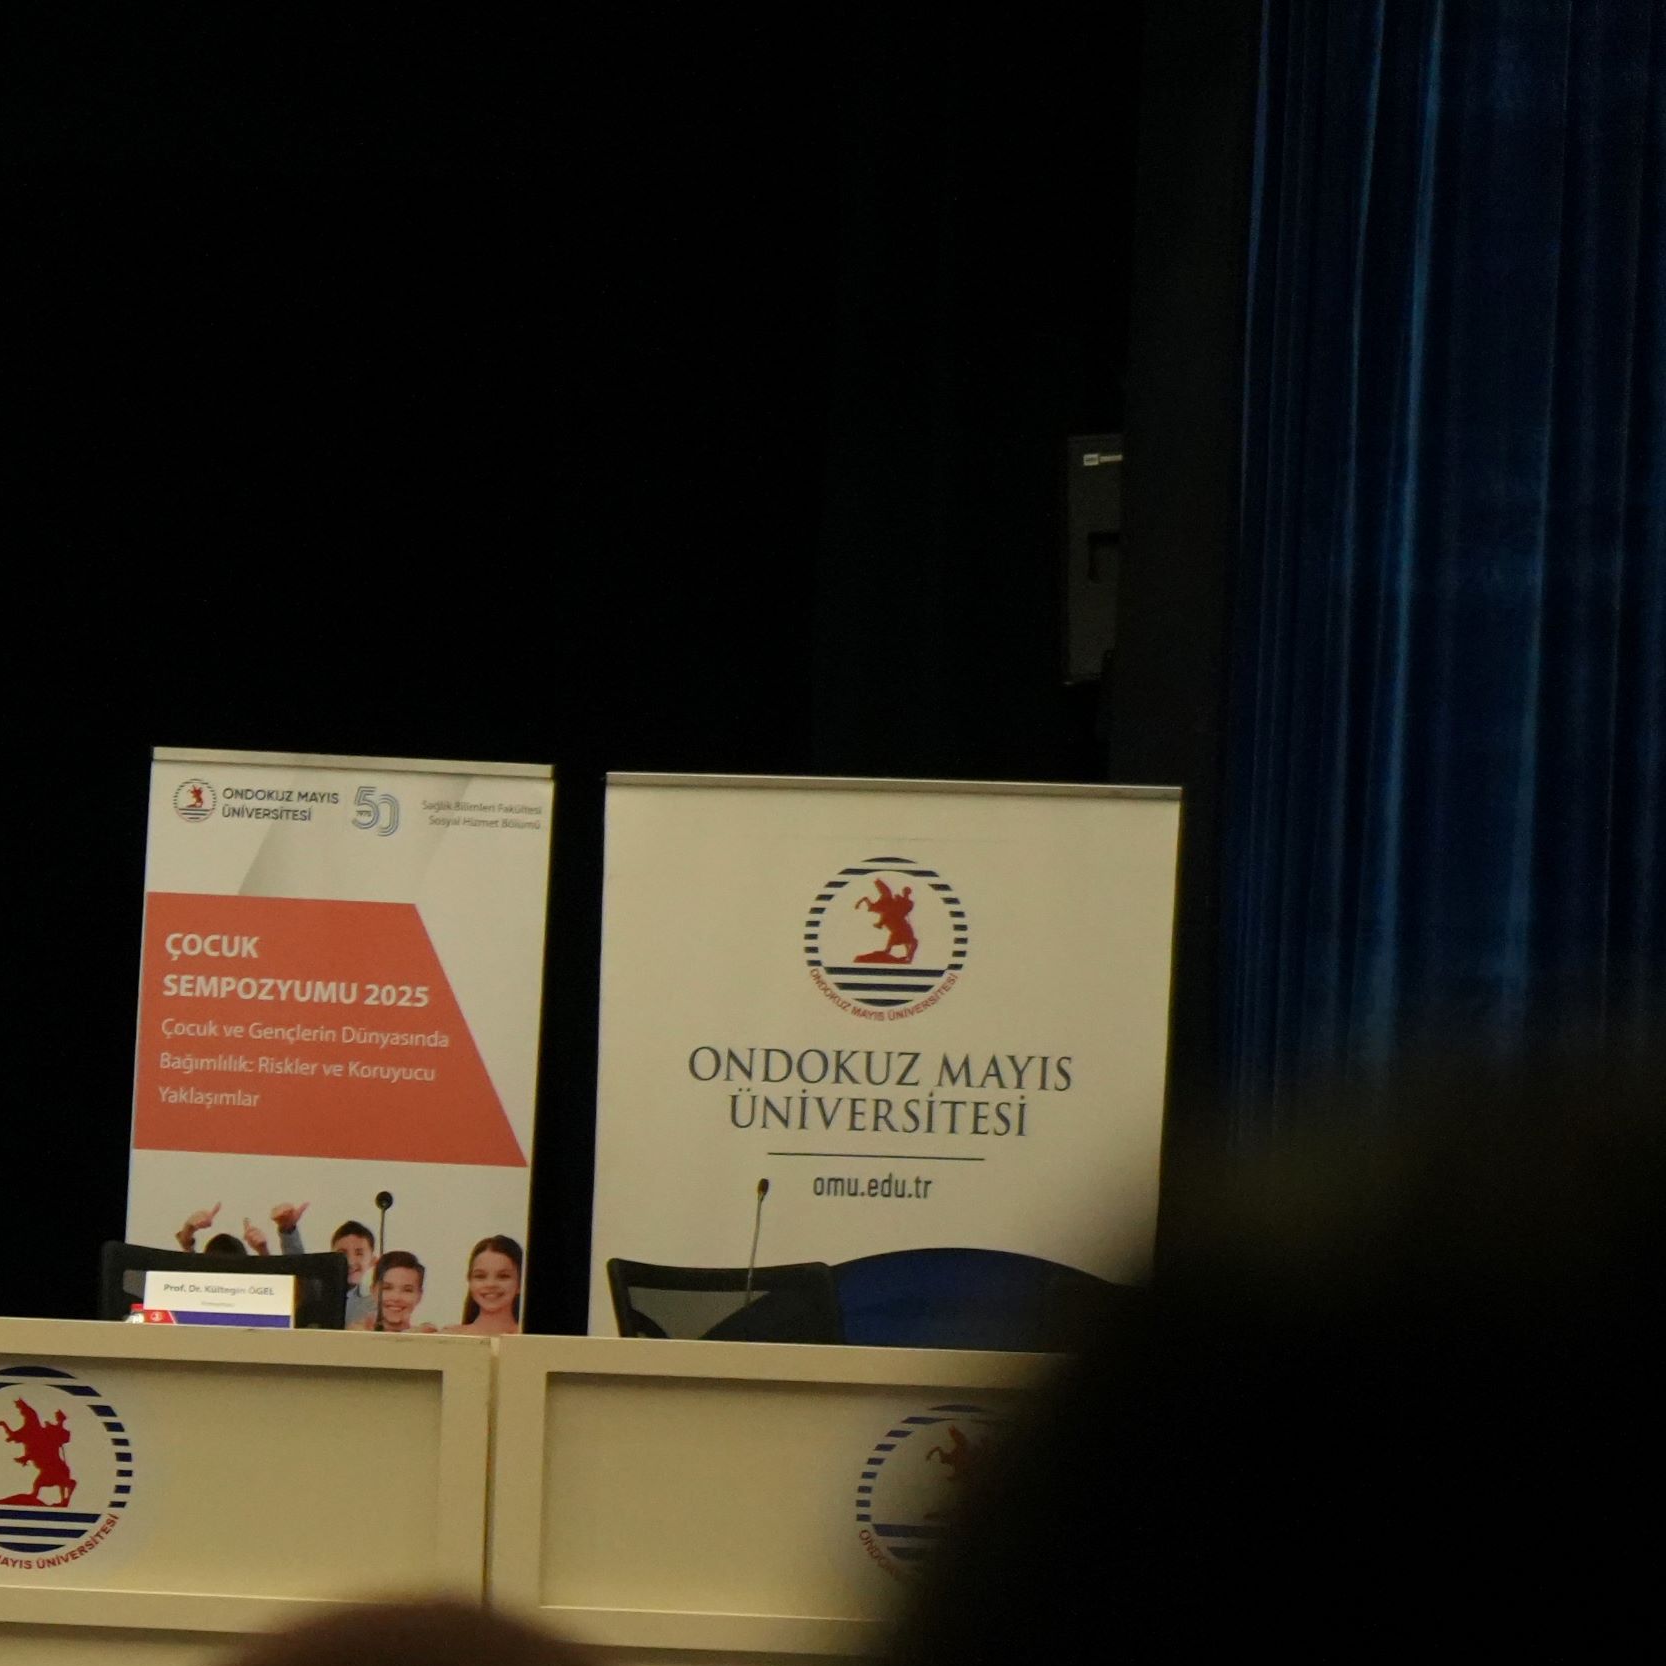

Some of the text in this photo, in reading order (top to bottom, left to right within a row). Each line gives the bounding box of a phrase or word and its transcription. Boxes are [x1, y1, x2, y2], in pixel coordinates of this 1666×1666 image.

[222, 787, 339, 805] ONDOKUZ MAYIS
[222, 804, 312, 822] ÜNİVERSİTESİ
[351, 785, 400, 837] 50
[428, 815, 460, 828] Sosyal
[165, 932, 260, 961] ÇOCUK
[162, 974, 430, 1008] SEMPOZYUMU 2025
[810, 968, 959, 1021] ONDOKUZ MAYIS ÜNİVERSİTESİ
[161, 1018, 450, 1049] Çocuk ve Gençlerin Dünyasında
[258, 1057, 318, 1076] Riskler
[322, 1064, 343, 1078] ve
[348, 1061, 437, 1083] Koruyucu
[688, 1046, 1073, 1092] ONDOKUZ MAYIS
[158, 1086, 260, 1109] Yaklaşımlar
[729, 1088, 1028, 1137] ÜNİVERSİTESİ
[812, 1172, 933, 1199] omu.edu.tr
[163, 1284, 186, 1293] Prof.
[189, 1285, 202, 1293] Dr.
[36, 1513, 120, 1570] ÜNİVERSİTESİ
